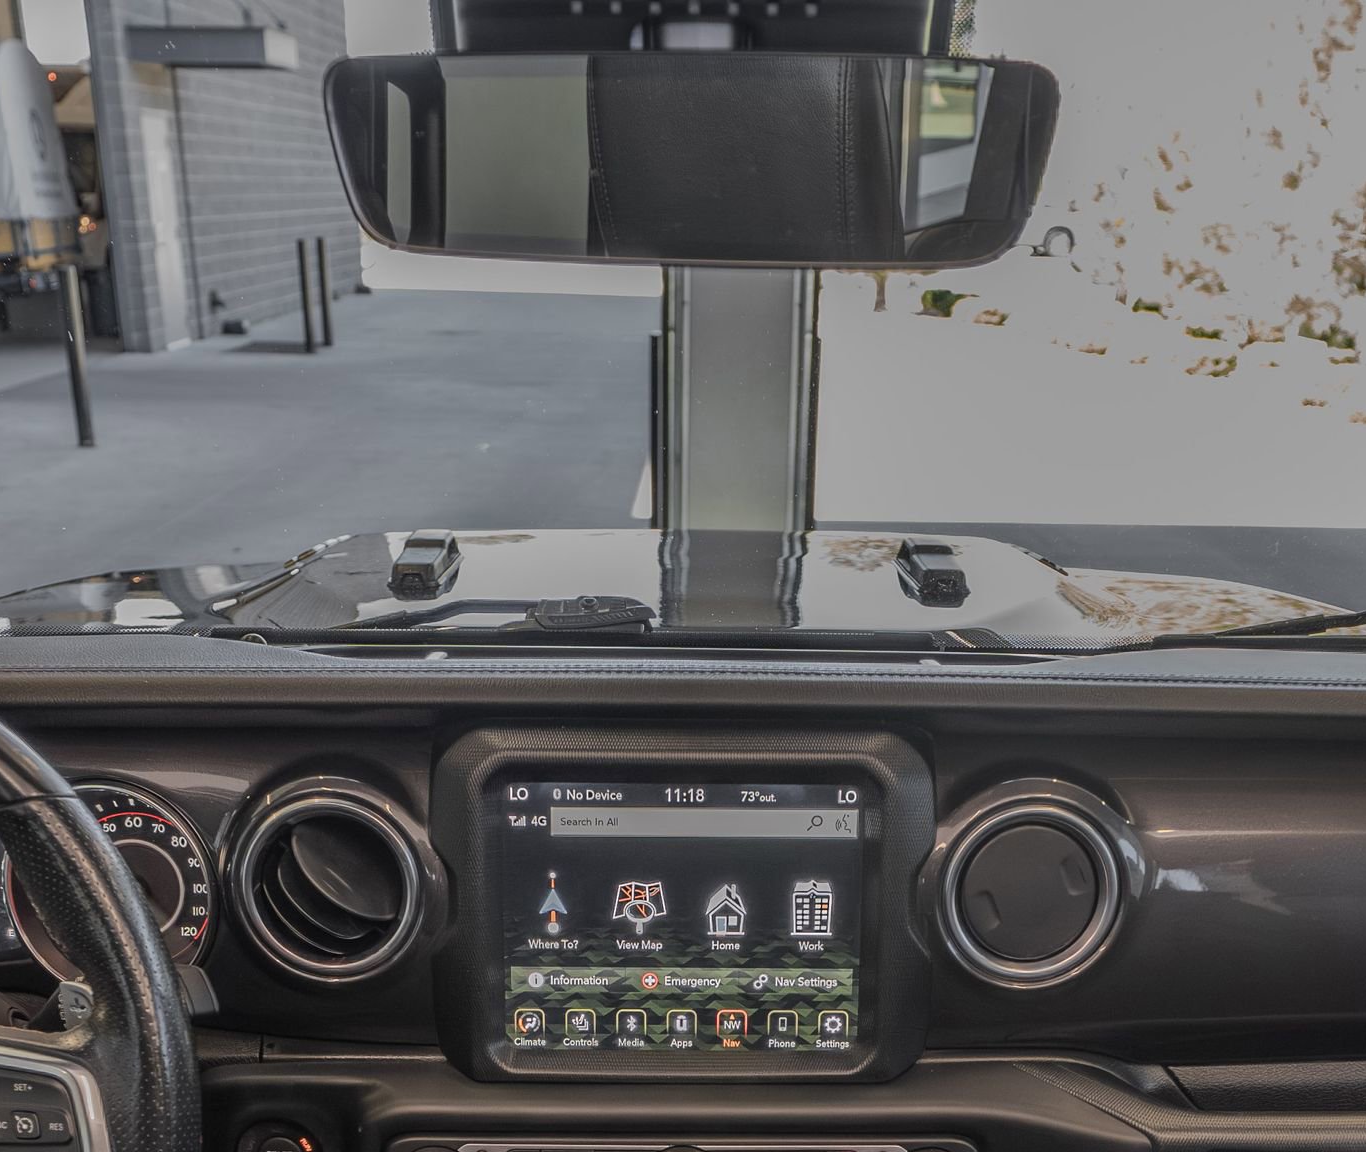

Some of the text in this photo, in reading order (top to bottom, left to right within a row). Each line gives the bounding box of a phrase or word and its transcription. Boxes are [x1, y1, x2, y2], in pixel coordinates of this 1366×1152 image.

[509, 787, 529, 801] LO
[566, 789, 623, 801] No Device
[664, 787, 705, 802] 11:18
[837, 789, 857, 803] LO
[124, 817, 142, 828] 60
[531, 815, 547, 826] 4G
[560, 817, 619, 827] Search In All
[102, 823, 116, 833] 50
[152, 823, 165, 833] 70
[171, 836, 187, 848] 80
[193, 884, 208, 894] 100
[192, 907, 205, 916] 110
[181, 927, 197, 937] 120
[528, 939, 579, 949] Where To?
[616, 939, 663, 951] View Map
[711, 940, 740, 950] Home
[798, 941, 824, 951] Work
[550, 975, 609, 986] Information
[664, 976, 721, 988] Emergency
[775, 977, 838, 988] Nav Settings
[514, 1038, 546, 1047] Climate
[563, 1038, 599, 1047] Controls
[618, 1038, 644, 1047] Media
[670, 1039, 693, 1048] Apps
[723, 1039, 740, 1048] Nav
[768, 1039, 795, 1048] Phone
[816, 1039, 849, 1050] Settings
[49, 1123, 64, 1131] RES
